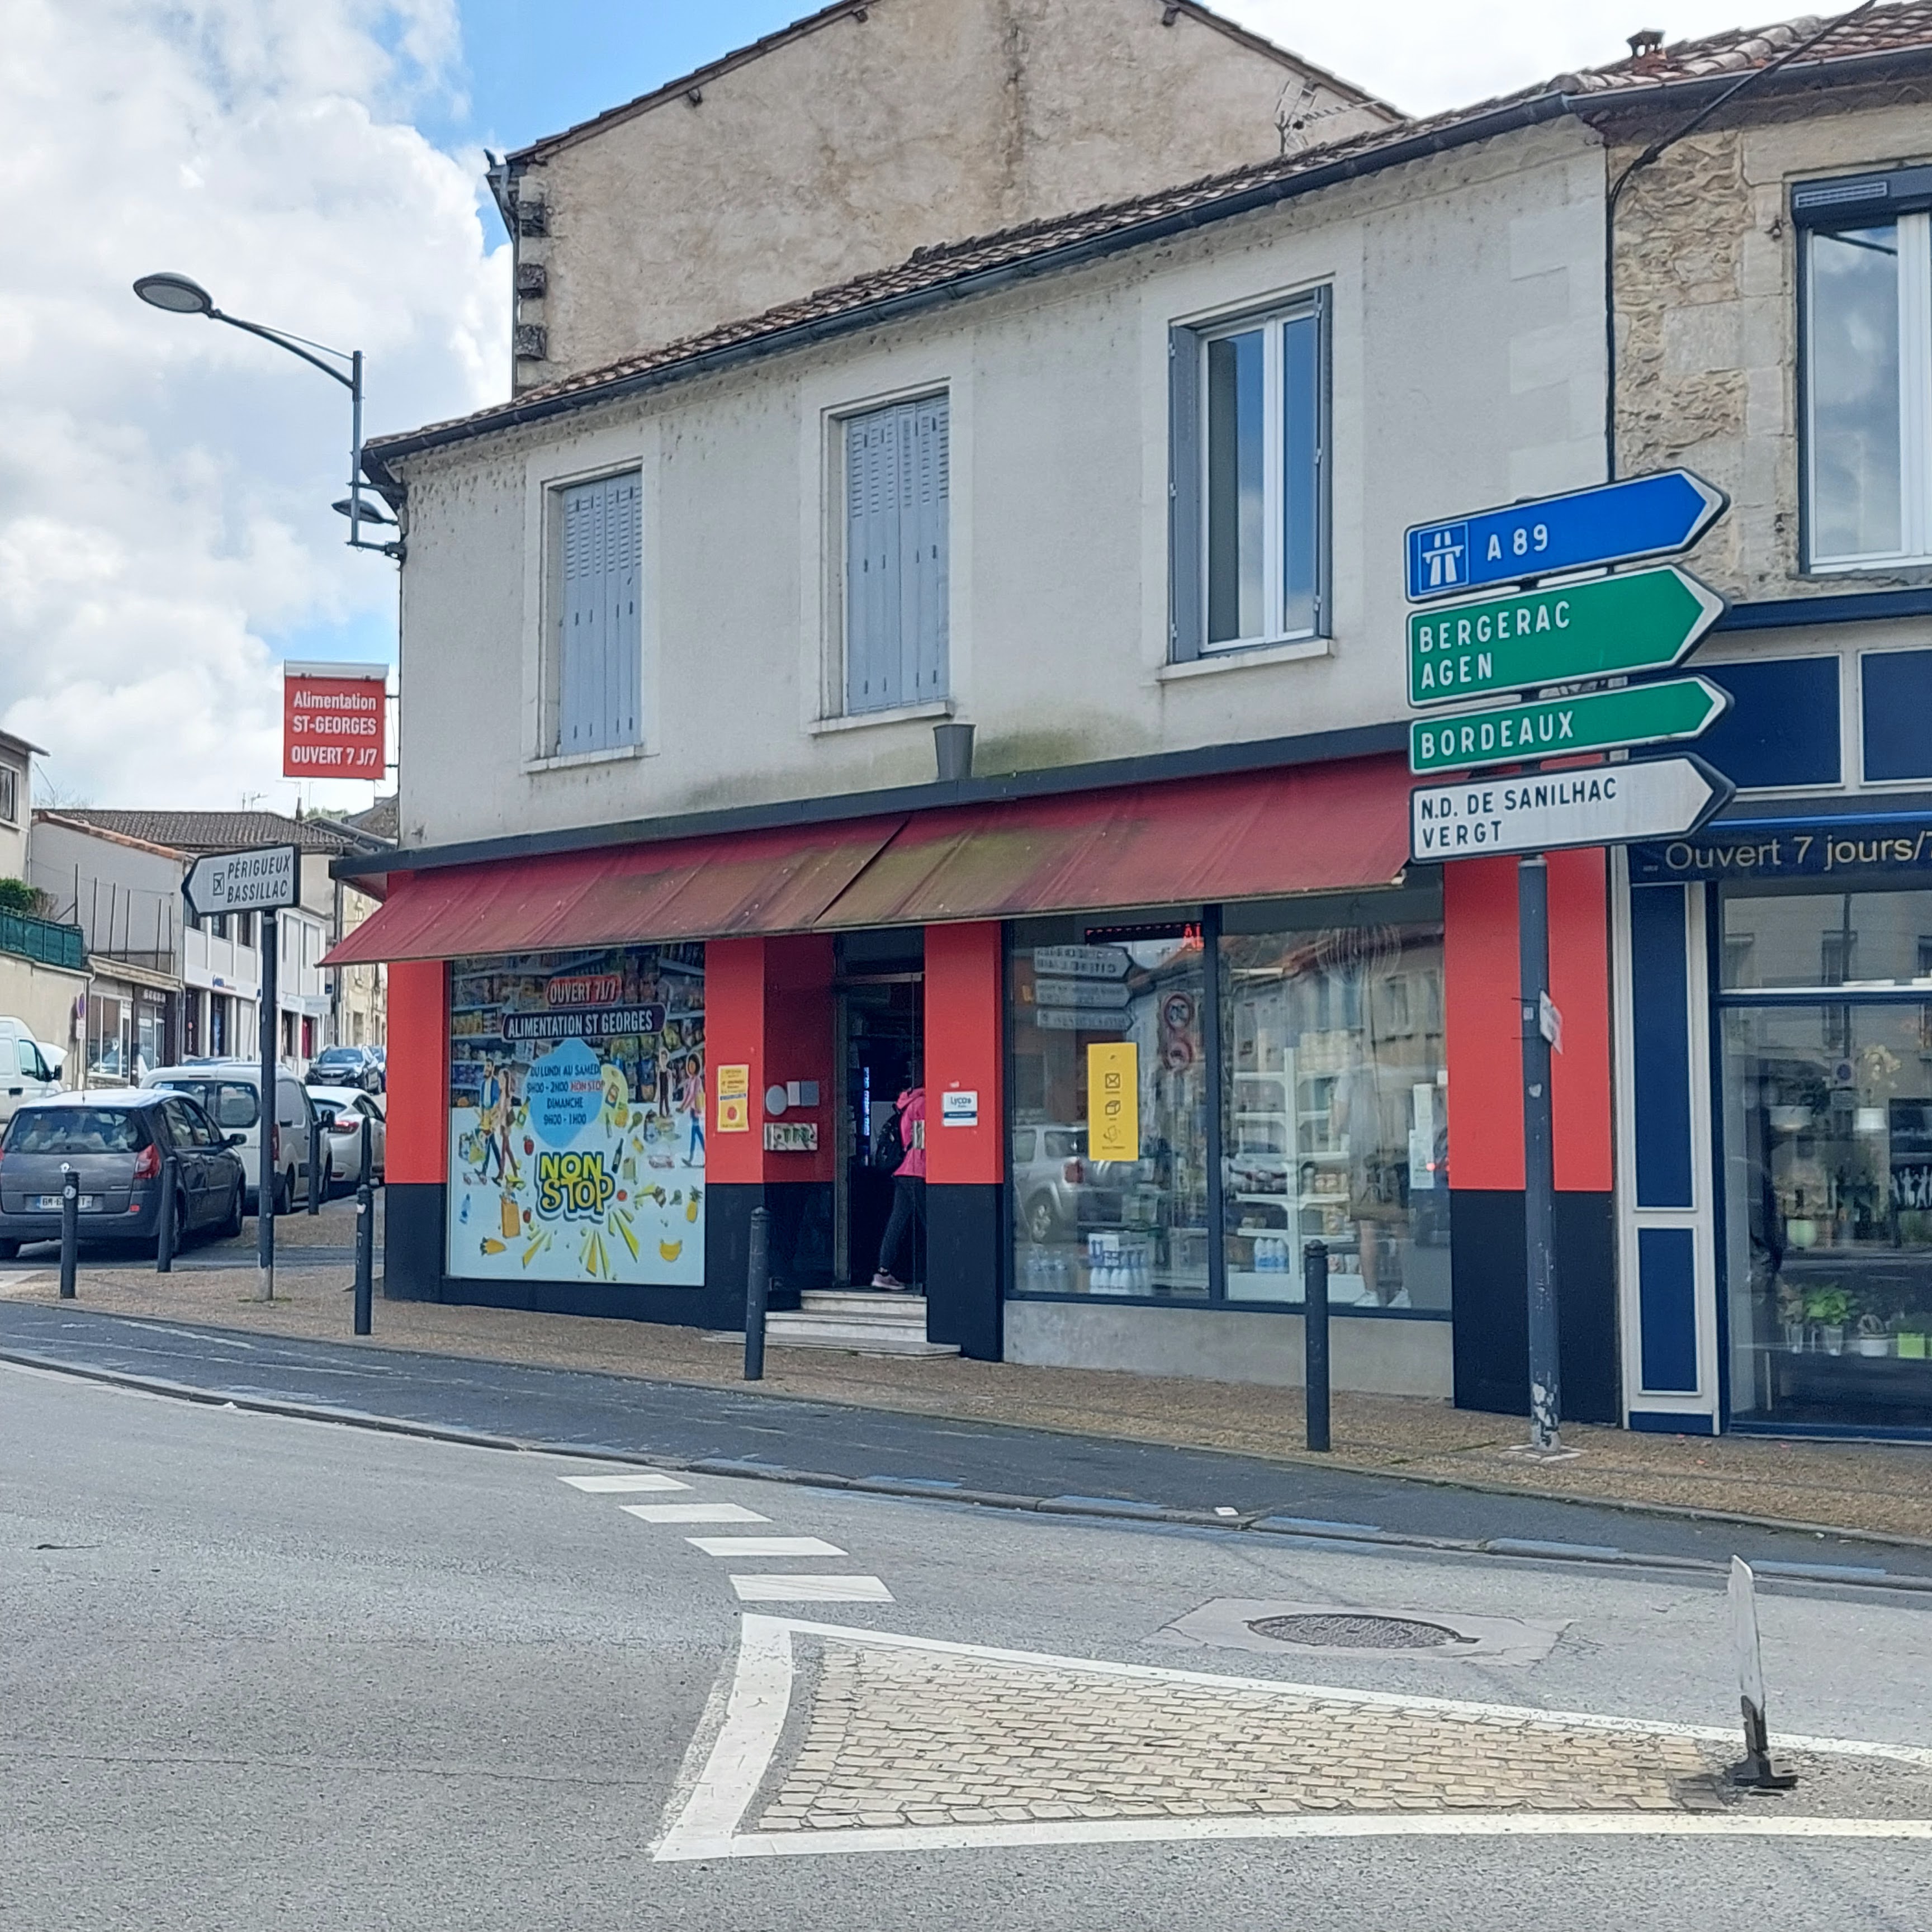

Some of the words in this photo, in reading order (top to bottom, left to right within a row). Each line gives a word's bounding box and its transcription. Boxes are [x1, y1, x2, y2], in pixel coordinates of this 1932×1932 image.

[1486, 534, 1502, 561] A
[1512, 523, 1549, 556] 89
[1419, 601, 1570, 653] BERGERAC
[1420, 652, 1493, 689] AGEN
[293, 690, 377, 711] Alimentation
[292, 715, 377, 735] ST-GEORGES
[1420, 711, 1574, 759] BORDEAUX
[291, 745, 344, 765] OUVERT
[1420, 798, 1458, 820] N.D.
[1467, 791, 1494, 813] DE
[1504, 777, 1617, 811] SANILHAC
[1422, 820, 1502, 849] VERGT
[228, 854, 291, 879] PÉRIGUEUX
[1665, 838, 1782, 870] Ouvert
[1793, 836, 1813, 864] 7
[227, 879, 287, 903] BASSILLAC
[550, 982, 591, 1003] OUVERT
[508, 1015, 583, 1038] ALIMENTATION
[585, 1013, 599, 1034] ST
[602, 1010, 653, 1032] GEORGES
[541, 1065, 561, 1077] LUNDI
[563, 1064, 573, 1076] AU
[547, 1096, 584, 1109] DIMANCHE
[540, 1152, 603, 1180] NON
[542, 1176, 613, 1213] STOP
